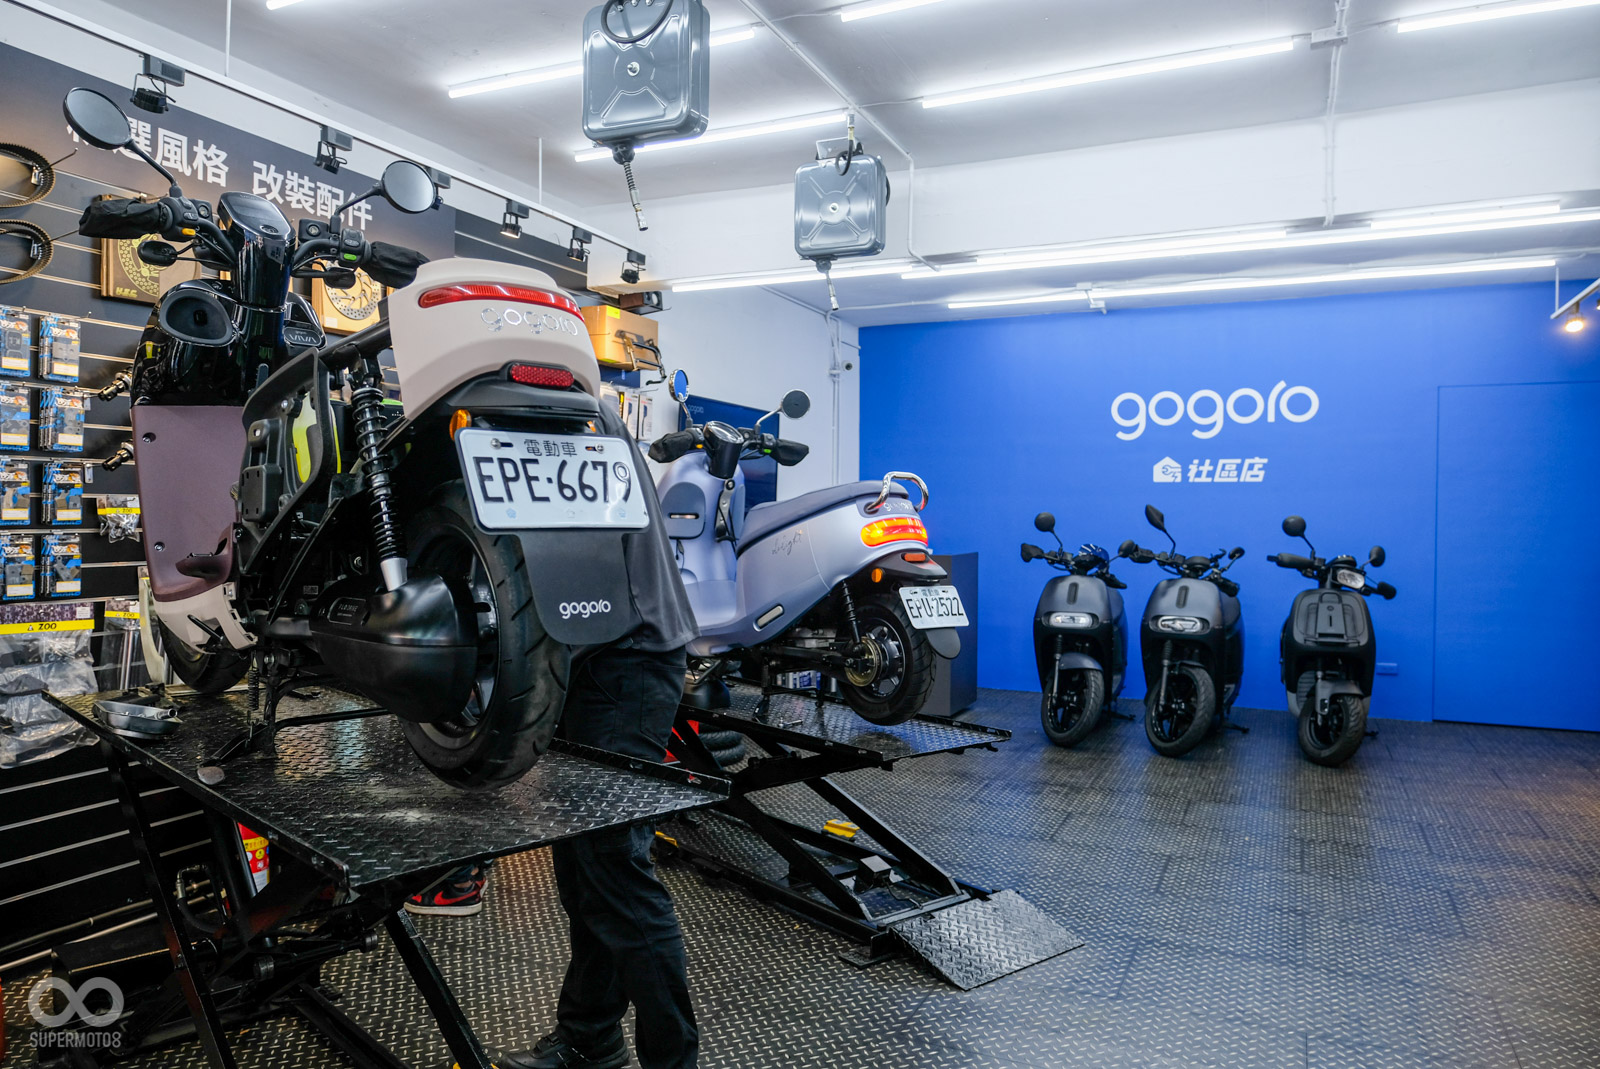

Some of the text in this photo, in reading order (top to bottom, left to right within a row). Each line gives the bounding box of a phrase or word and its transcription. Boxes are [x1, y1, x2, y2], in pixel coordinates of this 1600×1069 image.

[66, 116, 373, 231] 選風格 改裝配件
[481, 307, 578, 336] gogoro
[1111, 380, 1320, 441] gogoro
[523, 438, 578, 458] 電動車
[1187, 457, 1269, 483] 社區店
[559, 599, 611, 619] gogoro
[38, 622, 57, 631] ZOO
